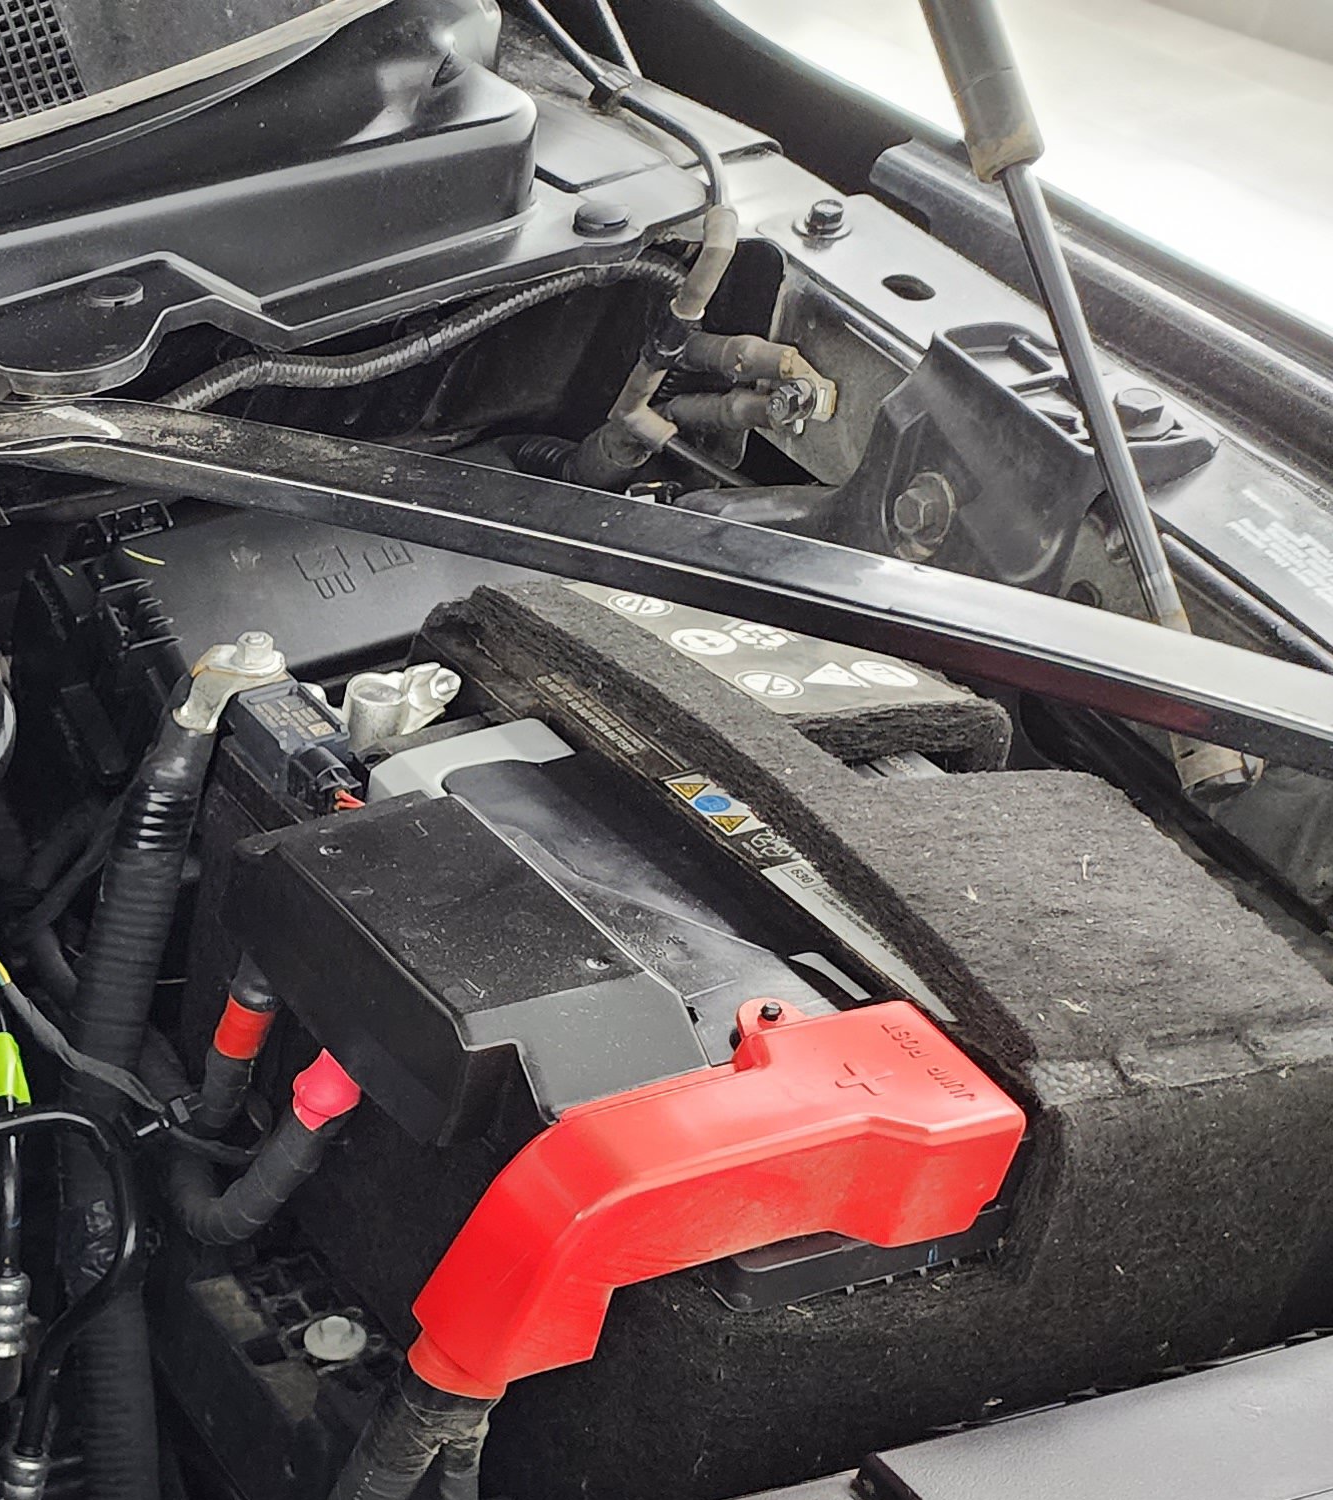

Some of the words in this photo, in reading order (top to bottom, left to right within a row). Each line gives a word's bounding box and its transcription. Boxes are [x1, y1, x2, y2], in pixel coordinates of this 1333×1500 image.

[789, 867, 816, 885] 630
[880, 1022, 931, 1060] POST
[926, 1065, 978, 1104] JUMP
